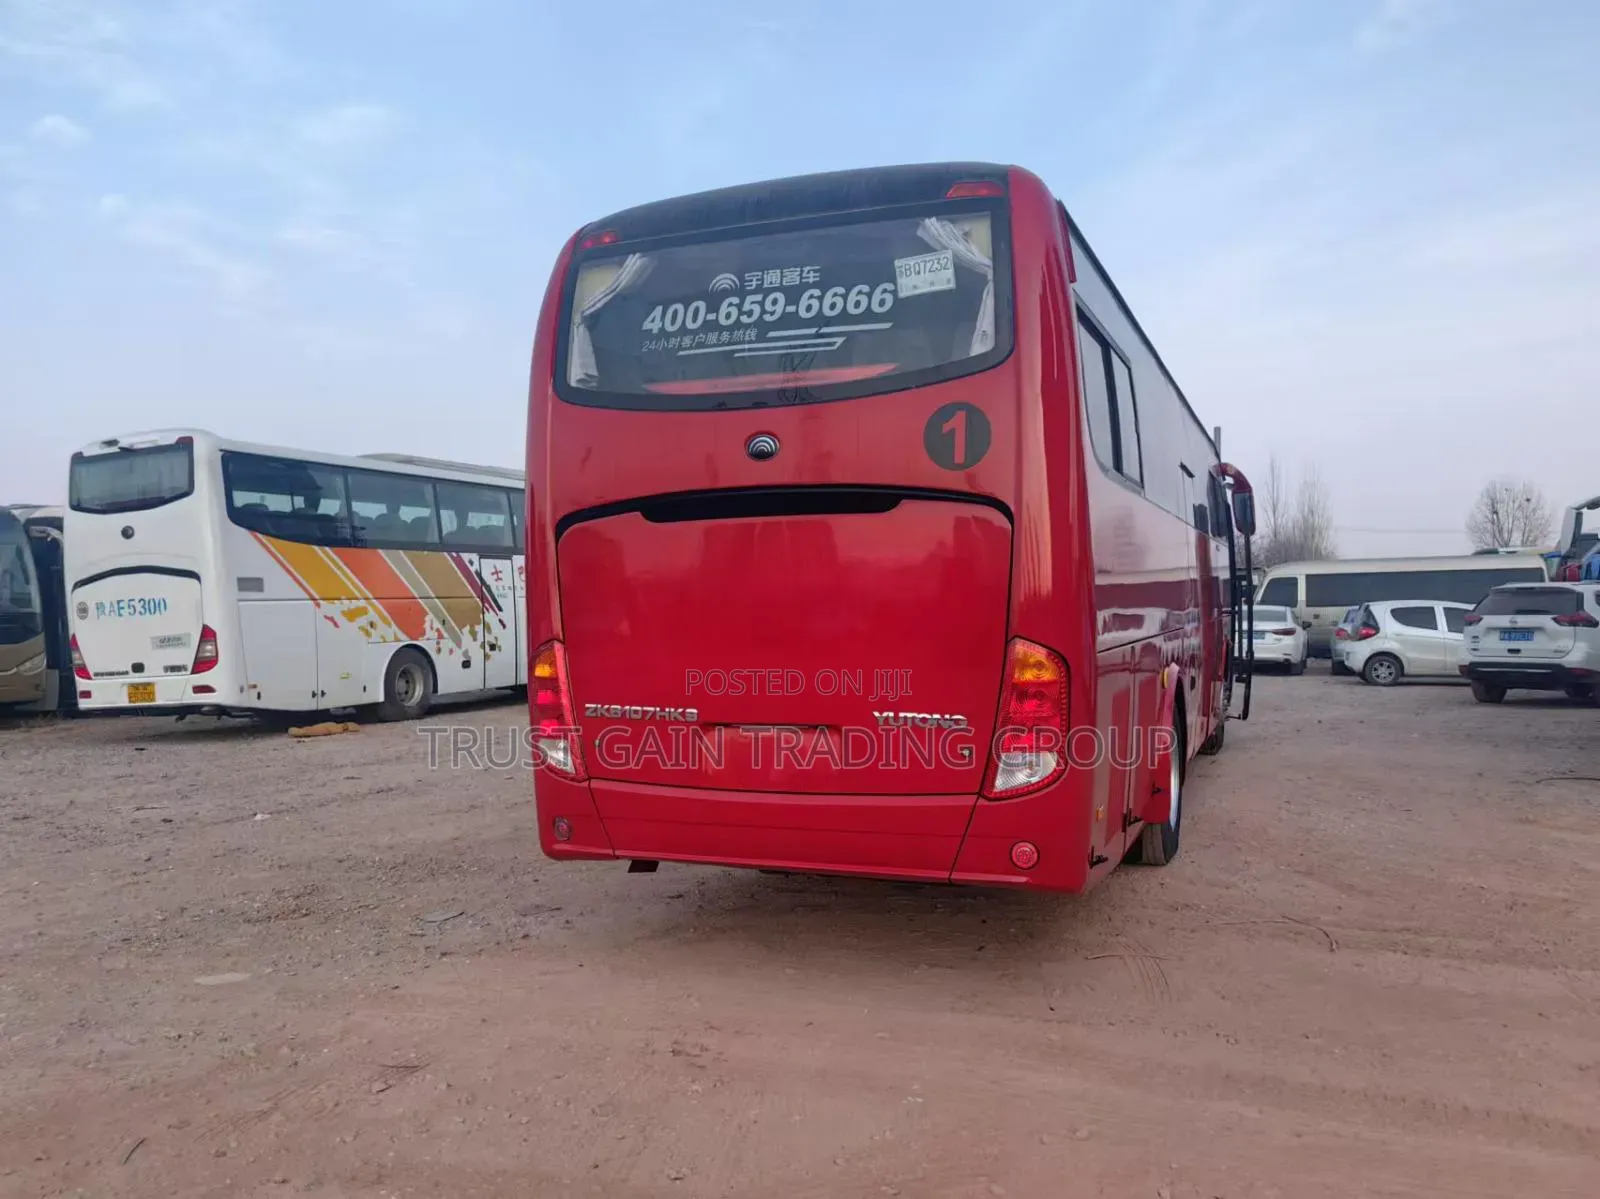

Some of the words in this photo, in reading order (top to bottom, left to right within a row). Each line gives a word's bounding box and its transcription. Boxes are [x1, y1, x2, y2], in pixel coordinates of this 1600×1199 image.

[744, 265, 821, 290] 宇通客车
[642, 282, 895, 334] 400-659-6666
[641, 327, 758, 352] 24小时客户服务热线
[942, 410, 967, 464] 1
[872, 711, 968, 729] YUTONG
